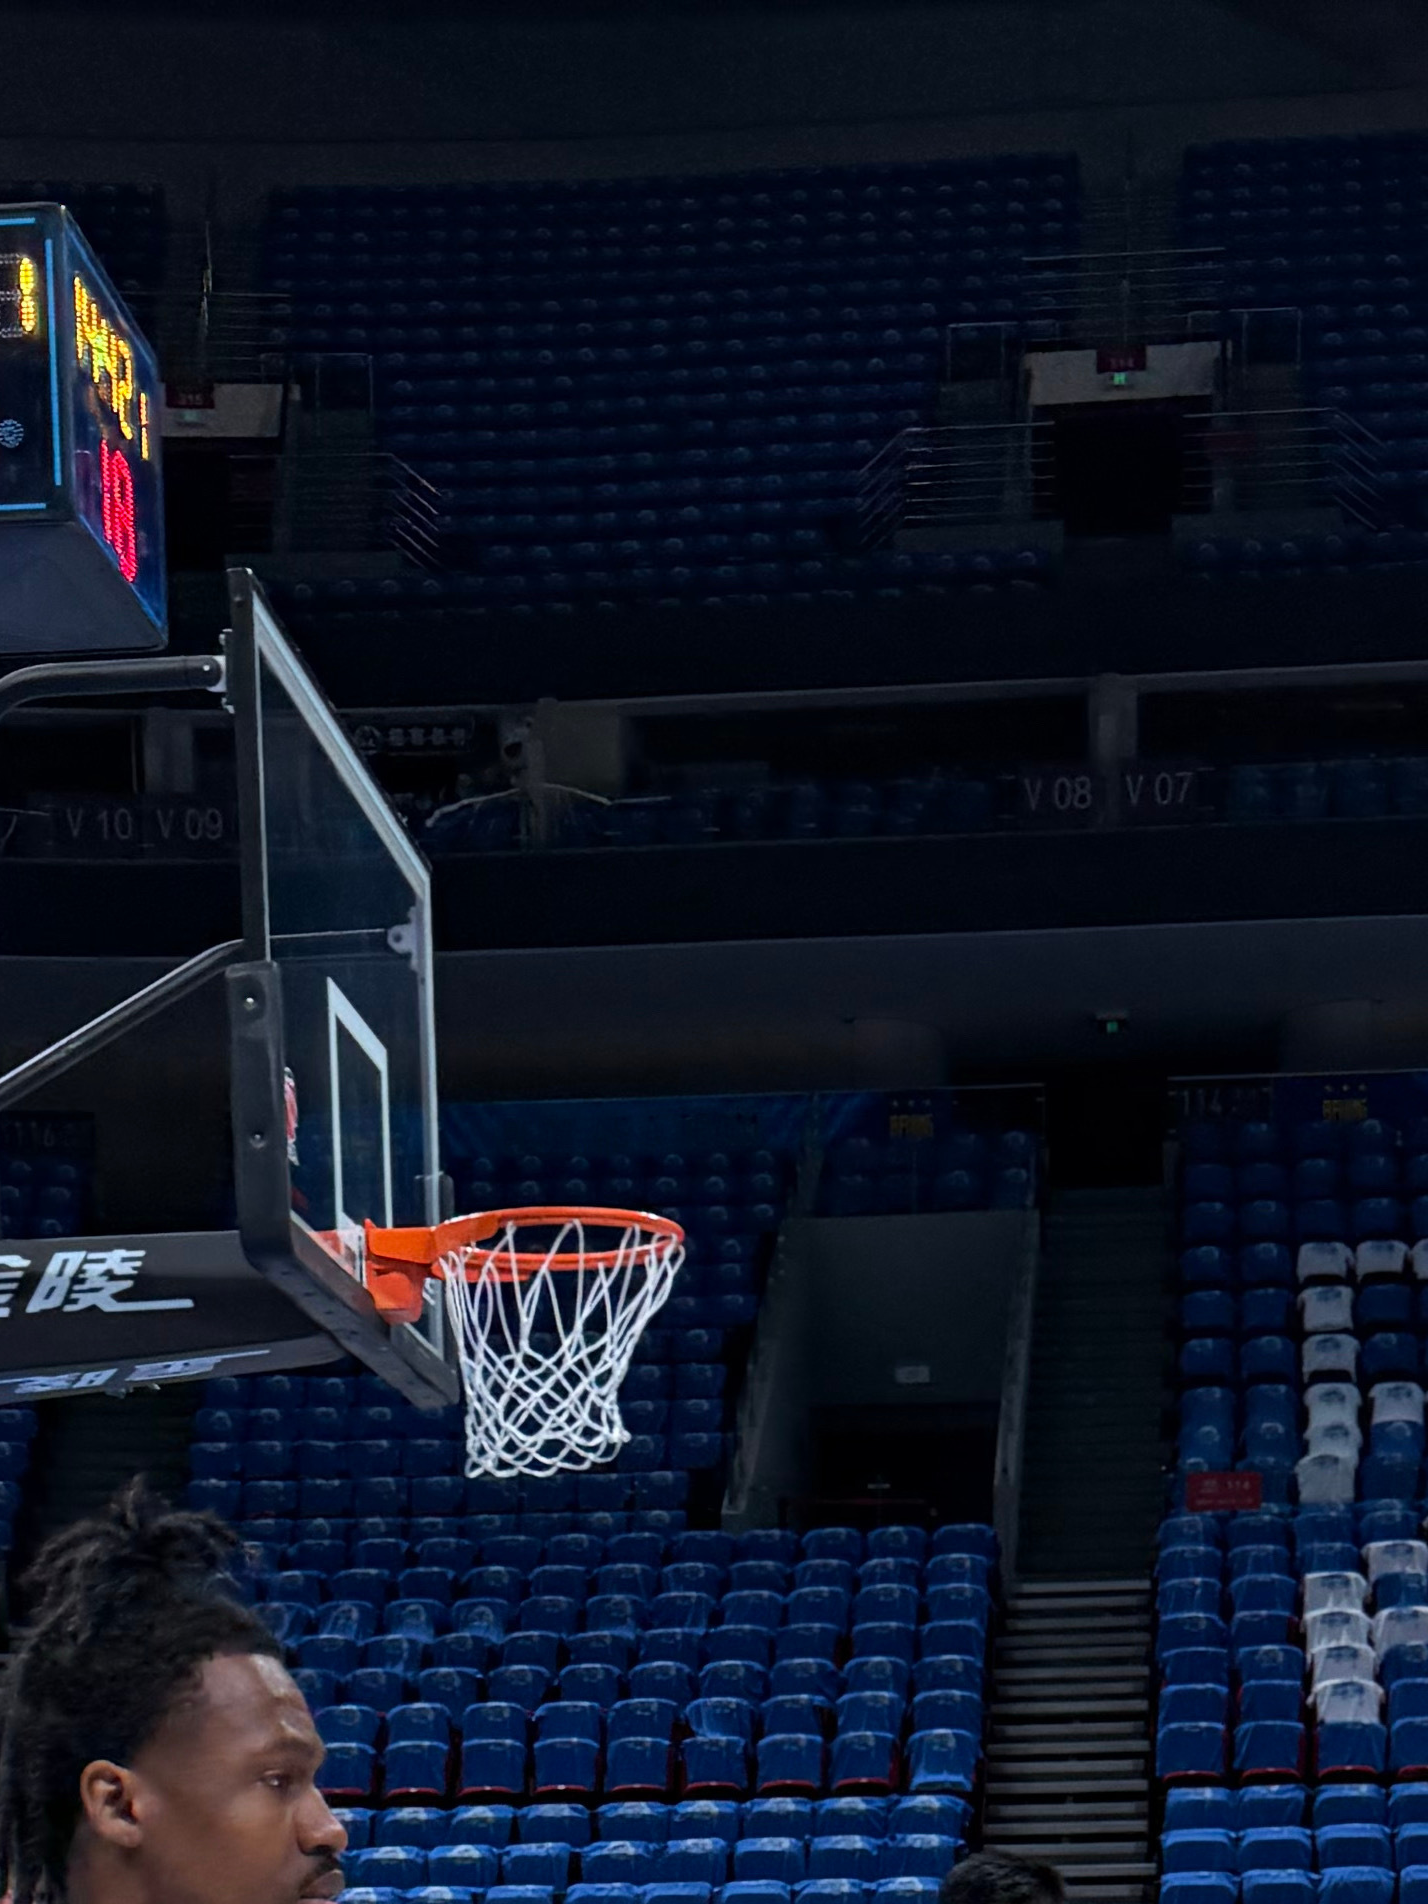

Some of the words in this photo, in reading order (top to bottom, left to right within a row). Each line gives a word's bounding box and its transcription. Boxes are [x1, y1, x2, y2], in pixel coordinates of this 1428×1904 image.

[1024, 778, 1042, 811] V
[1054, 776, 1092, 810] 08
[1125, 774, 1144, 805] V
[1154, 771, 1194, 804] 07
[66, 807, 84, 838] V
[98, 808, 132, 840] 10
[156, 808, 174, 839] V
[184, 808, 222, 840] 09
